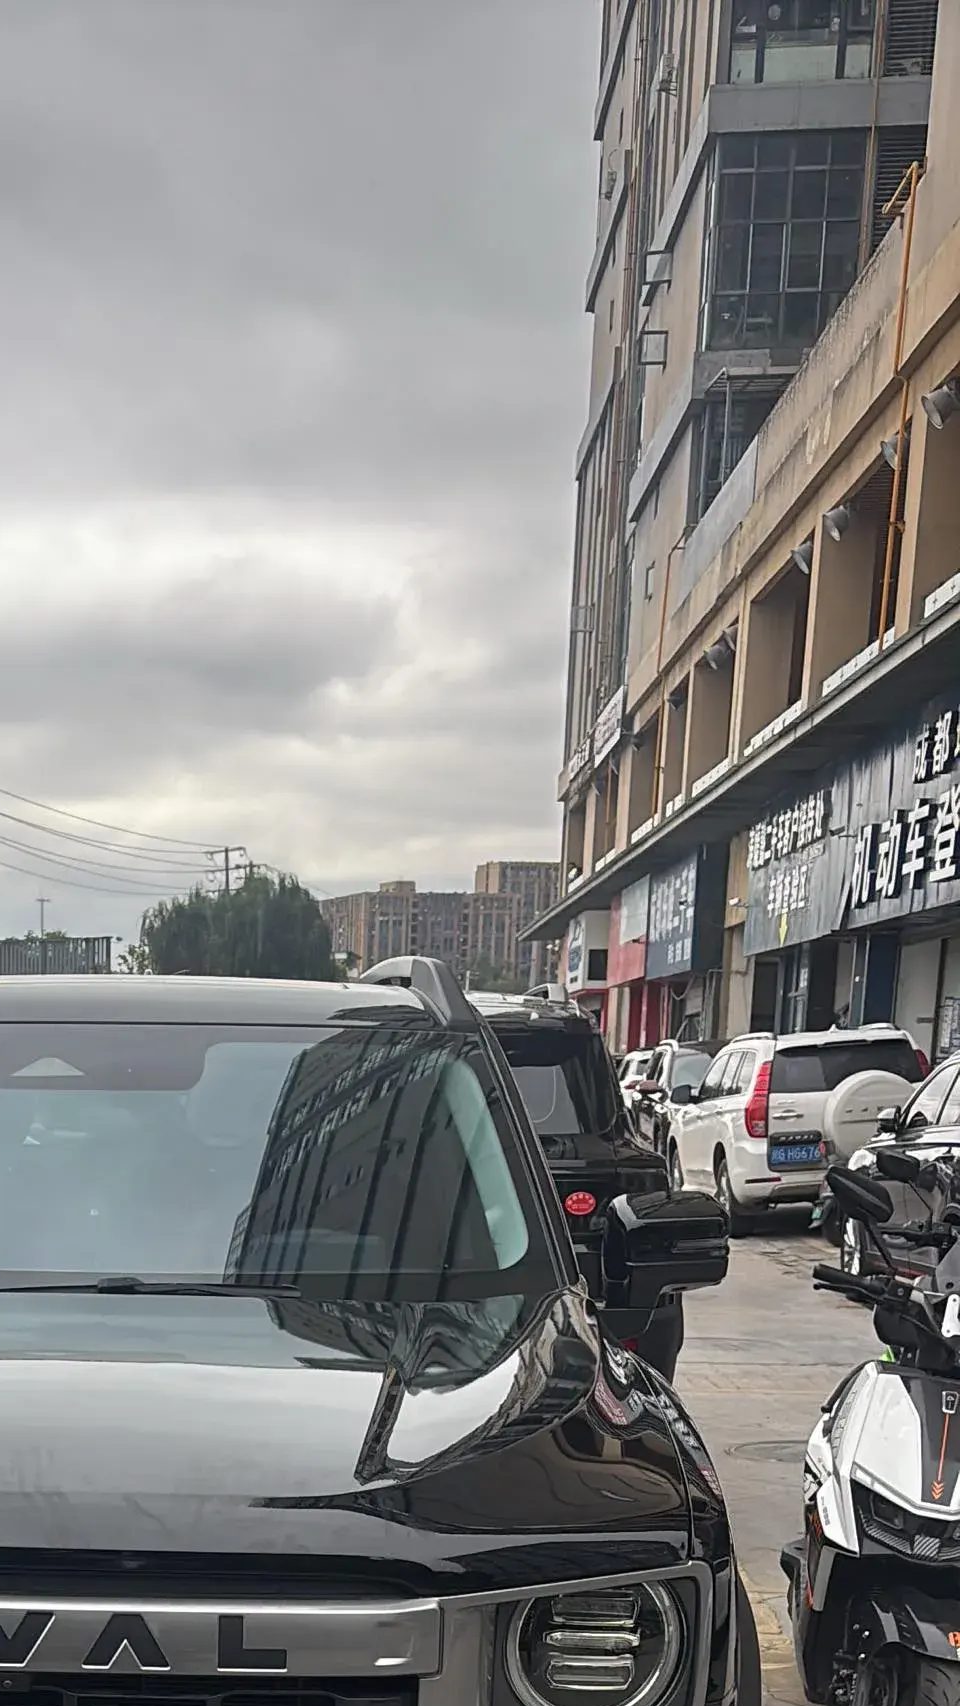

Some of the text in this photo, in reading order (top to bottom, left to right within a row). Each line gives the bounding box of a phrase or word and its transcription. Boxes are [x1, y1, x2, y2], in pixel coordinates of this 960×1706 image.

[912, 704, 960, 781] 成都
[851, 784, 960, 909] 机动车登
